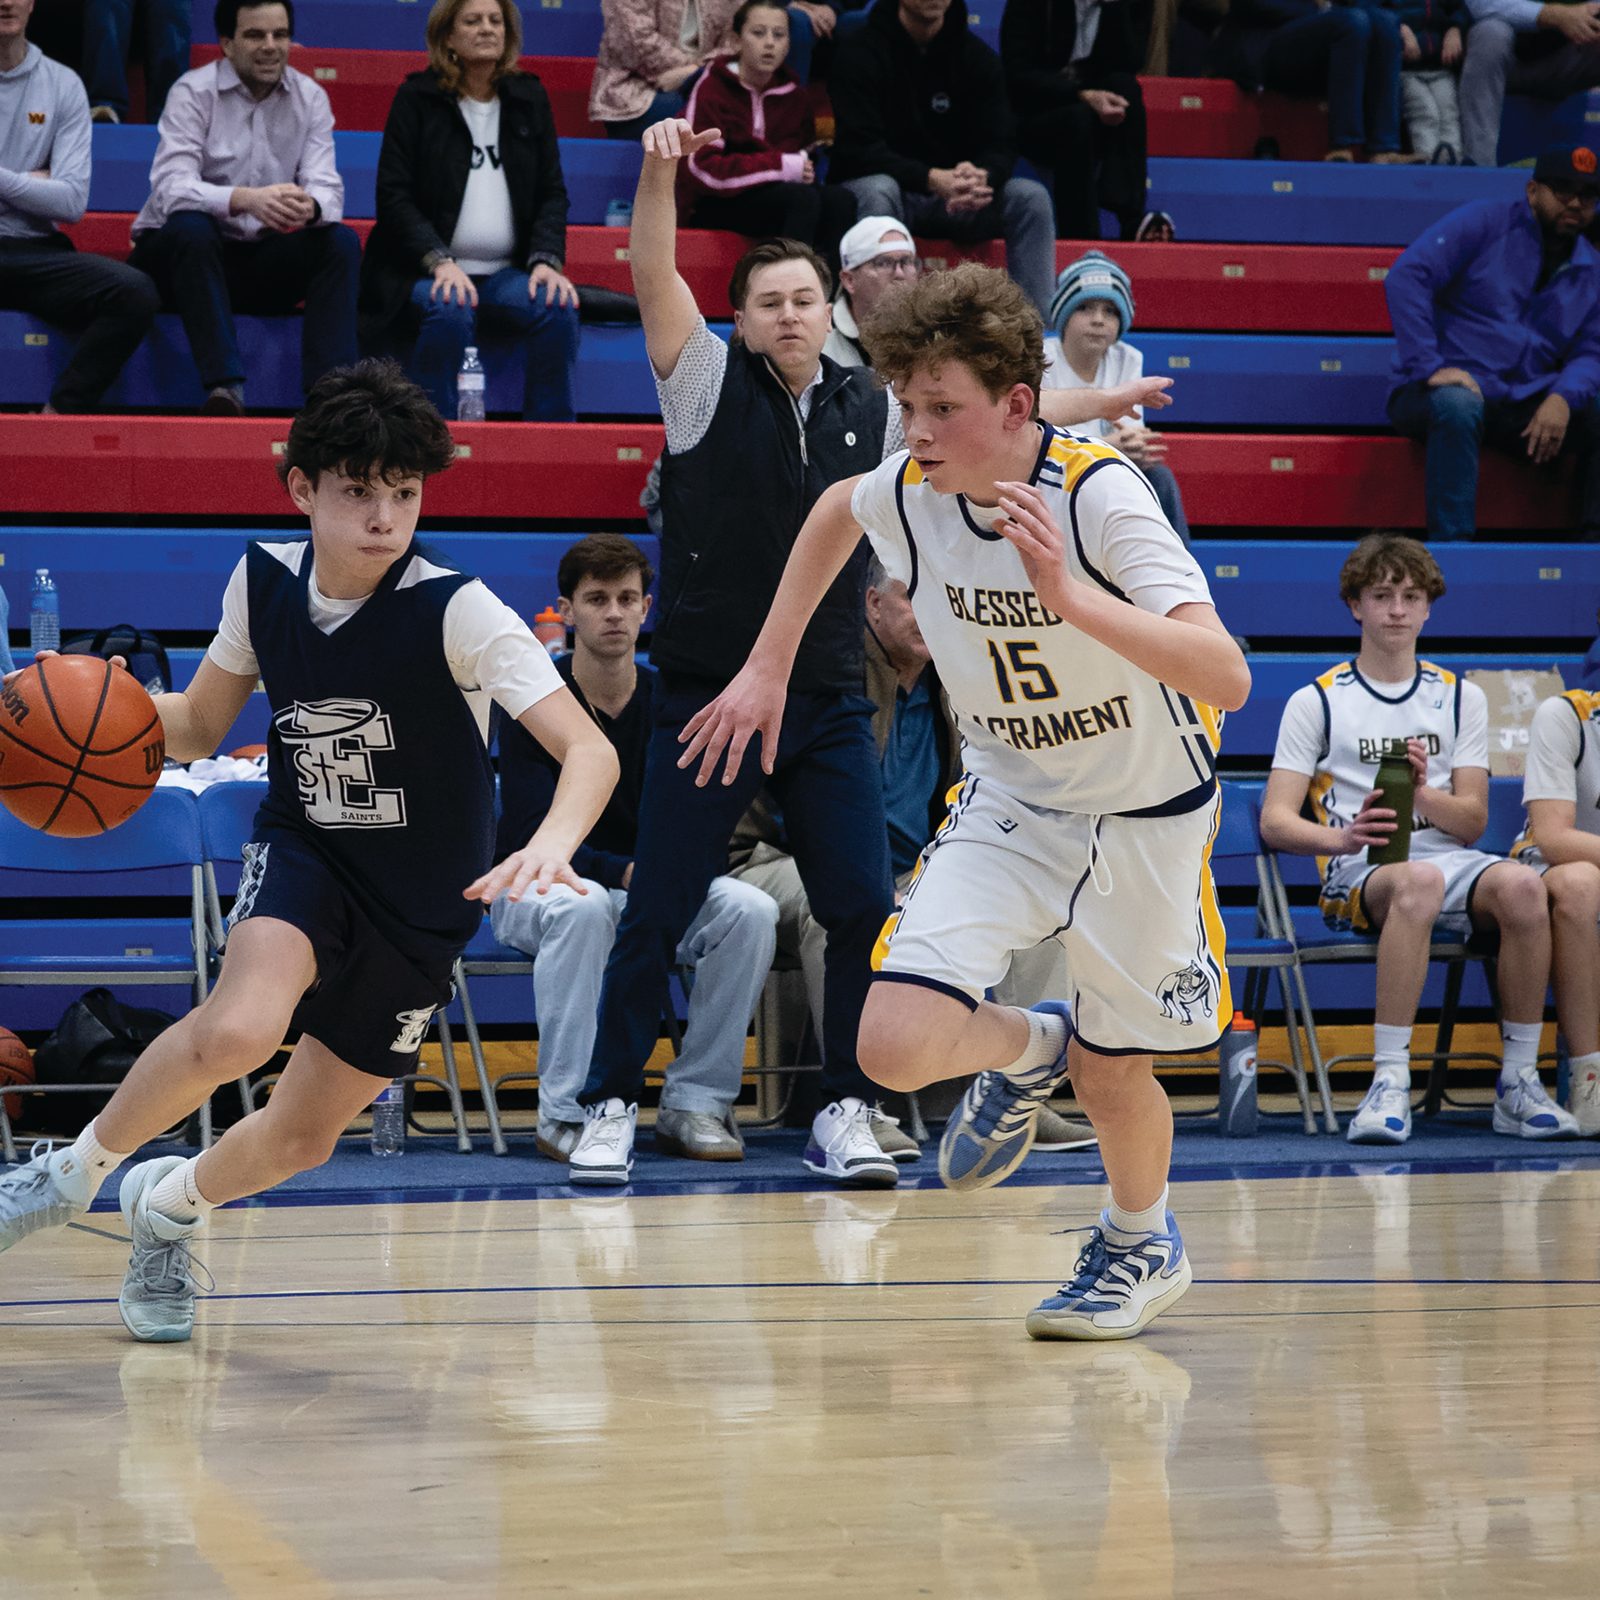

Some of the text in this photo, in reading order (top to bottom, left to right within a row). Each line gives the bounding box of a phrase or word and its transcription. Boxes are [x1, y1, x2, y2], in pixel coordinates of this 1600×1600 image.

[986, 636, 1061, 705] 15
[973, 694, 1133, 751] CRAMENT
[341, 811, 383, 822] SAINTS
